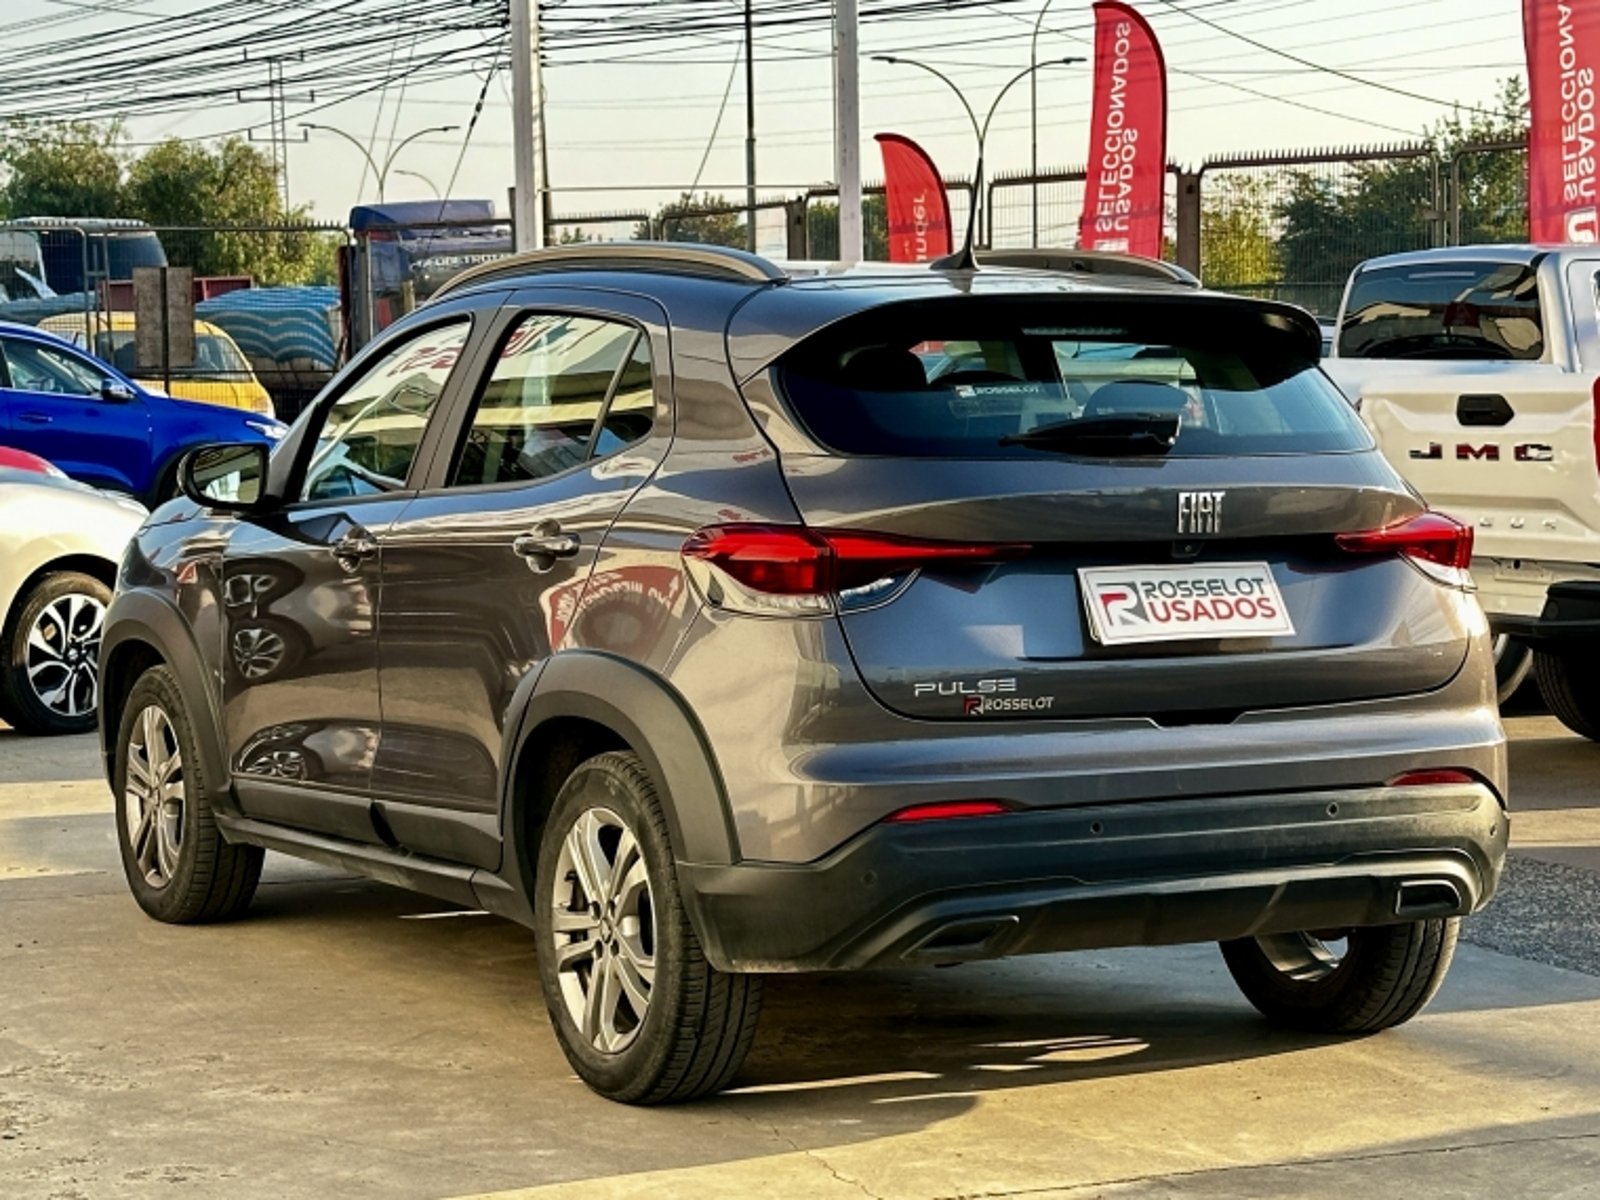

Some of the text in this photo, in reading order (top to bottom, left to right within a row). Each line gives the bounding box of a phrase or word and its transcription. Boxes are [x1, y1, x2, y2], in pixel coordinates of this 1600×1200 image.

[1409, 442, 1553, 462] JMC
[1177, 491, 1227, 534] FIAT
[1141, 577, 1265, 599] ROSSELOT
[1149, 598, 1277, 623] USADOS
[914, 677, 1017, 698] PULSE
[984, 696, 1055, 711] ROSSELOT
